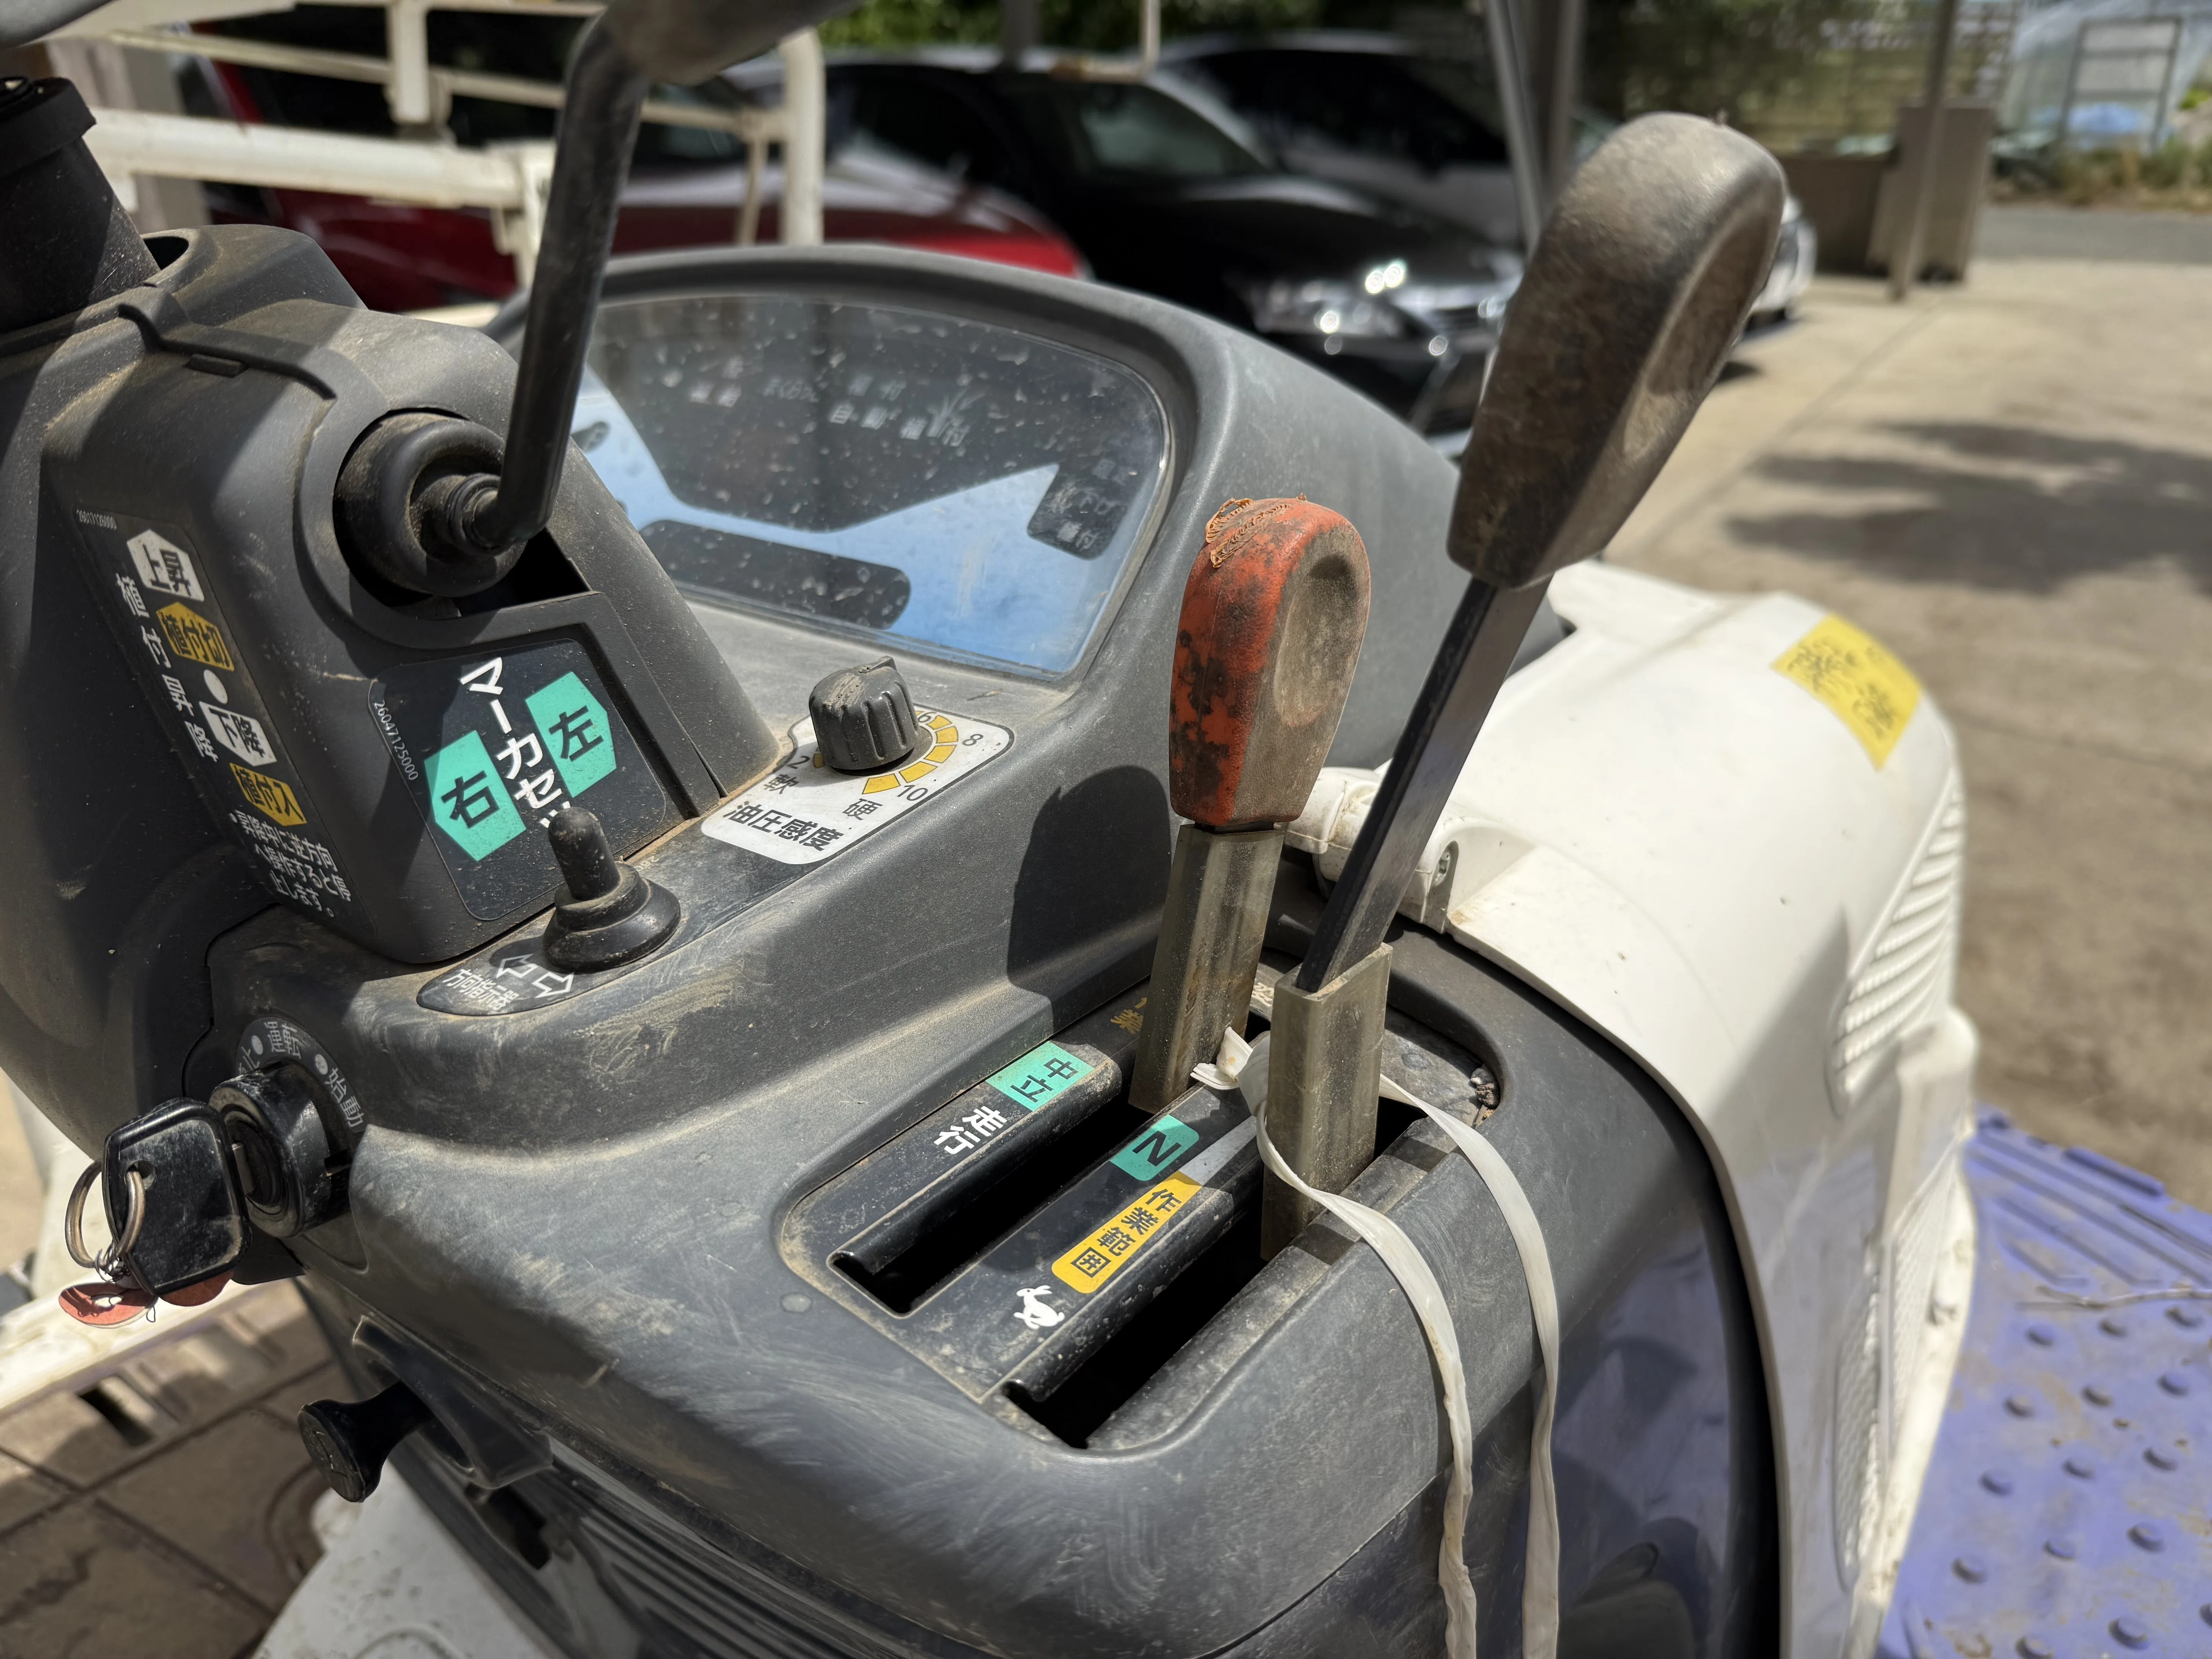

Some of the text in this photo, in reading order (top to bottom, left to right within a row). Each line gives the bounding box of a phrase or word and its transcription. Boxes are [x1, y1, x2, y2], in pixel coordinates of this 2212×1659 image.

[140, 544, 193, 596] 上昇
[159, 611, 229, 667] 植付切
[116, 573, 218, 762] 植付昇降
[208, 710, 267, 757] 下降
[373, 699, 419, 780] 26047125000
[549, 705, 603, 761] 左
[918, 711, 937, 723] 6
[962, 733, 984, 746] 8
[764, 773, 799, 794] 軟
[787, 756, 811, 769] 2
[234, 766, 304, 823] 植付入
[441, 771, 500, 829] 右
[842, 798, 883, 821] 硬
[896, 785, 928, 801] 10
[723, 801, 845, 852] 油圧感度
[270, 870, 335, 917] 止します。
[442, 969, 520, 1010] 方向指示器
[325, 1068, 365, 1127] 始動
[1010, 1056, 1079, 1104] 中立
[933, 1105, 1008, 1154] 走行
[1132, 1130, 1182, 1166] N
[1070, 1188, 1183, 1278] 作業範囲
